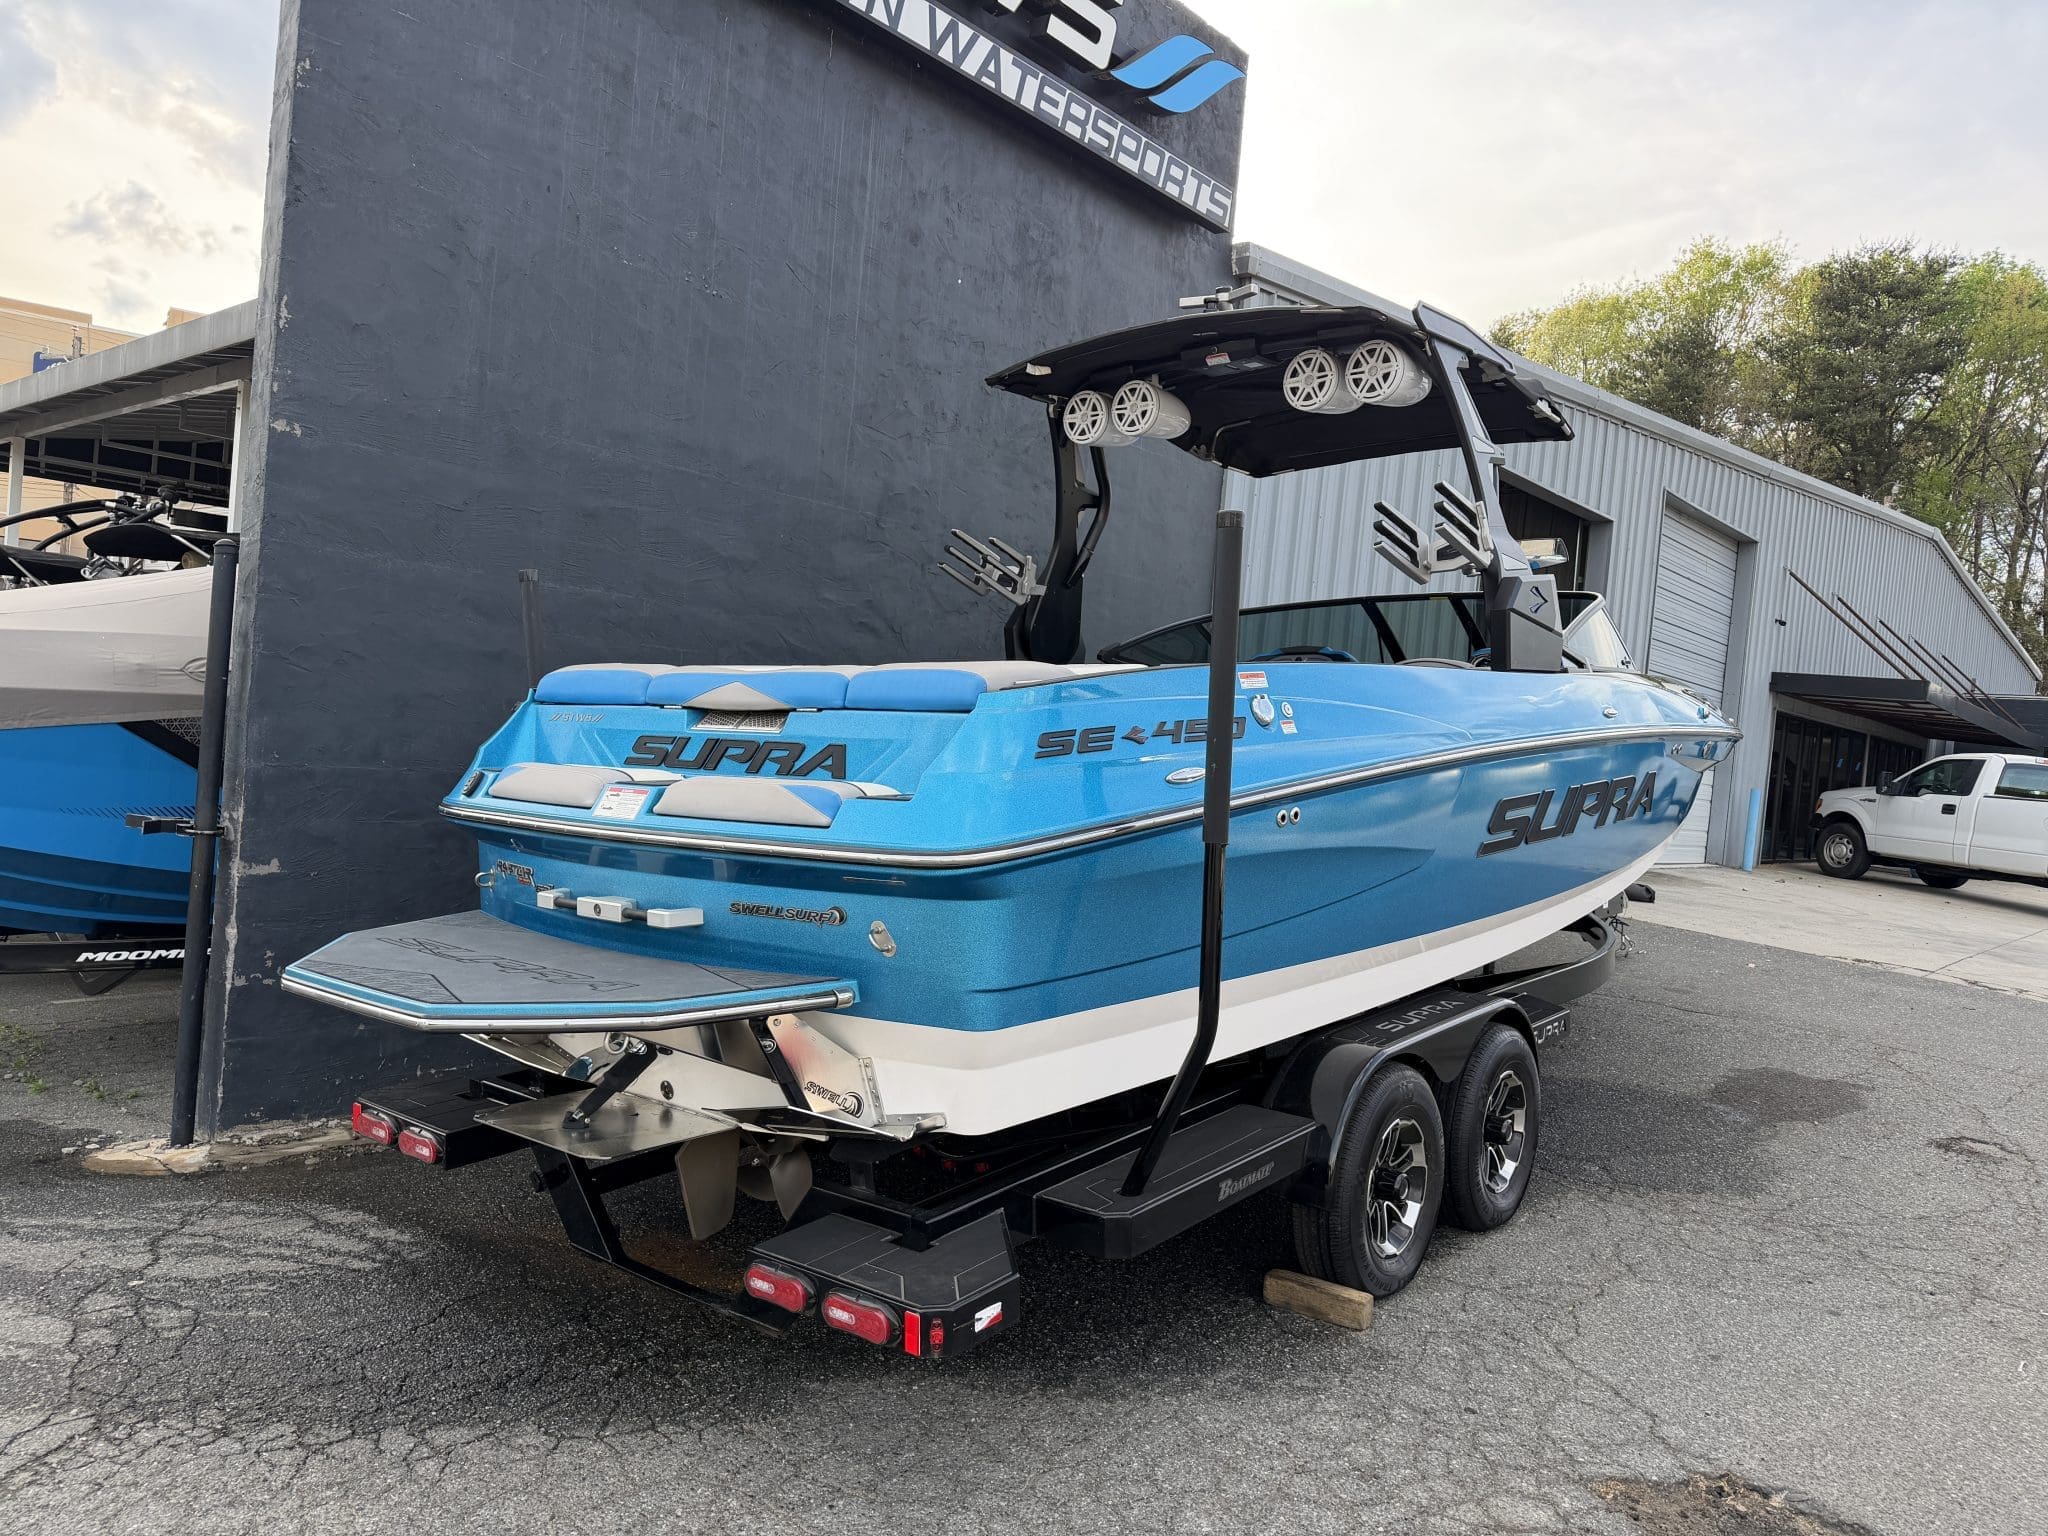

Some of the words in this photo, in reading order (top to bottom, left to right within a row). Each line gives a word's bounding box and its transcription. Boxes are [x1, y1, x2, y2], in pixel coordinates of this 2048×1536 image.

[929, 4, 1232, 222] WATERSPORTS
[624, 735, 847, 779] SUPRA
[1034, 725, 1116, 759] SE
[1476, 771, 1657, 858] SUPRA
[729, 901, 834, 925] SWELLSURF
[1376, 1000, 1465, 1033] SUPRA
[804, 1081, 851, 1110] SWELL
